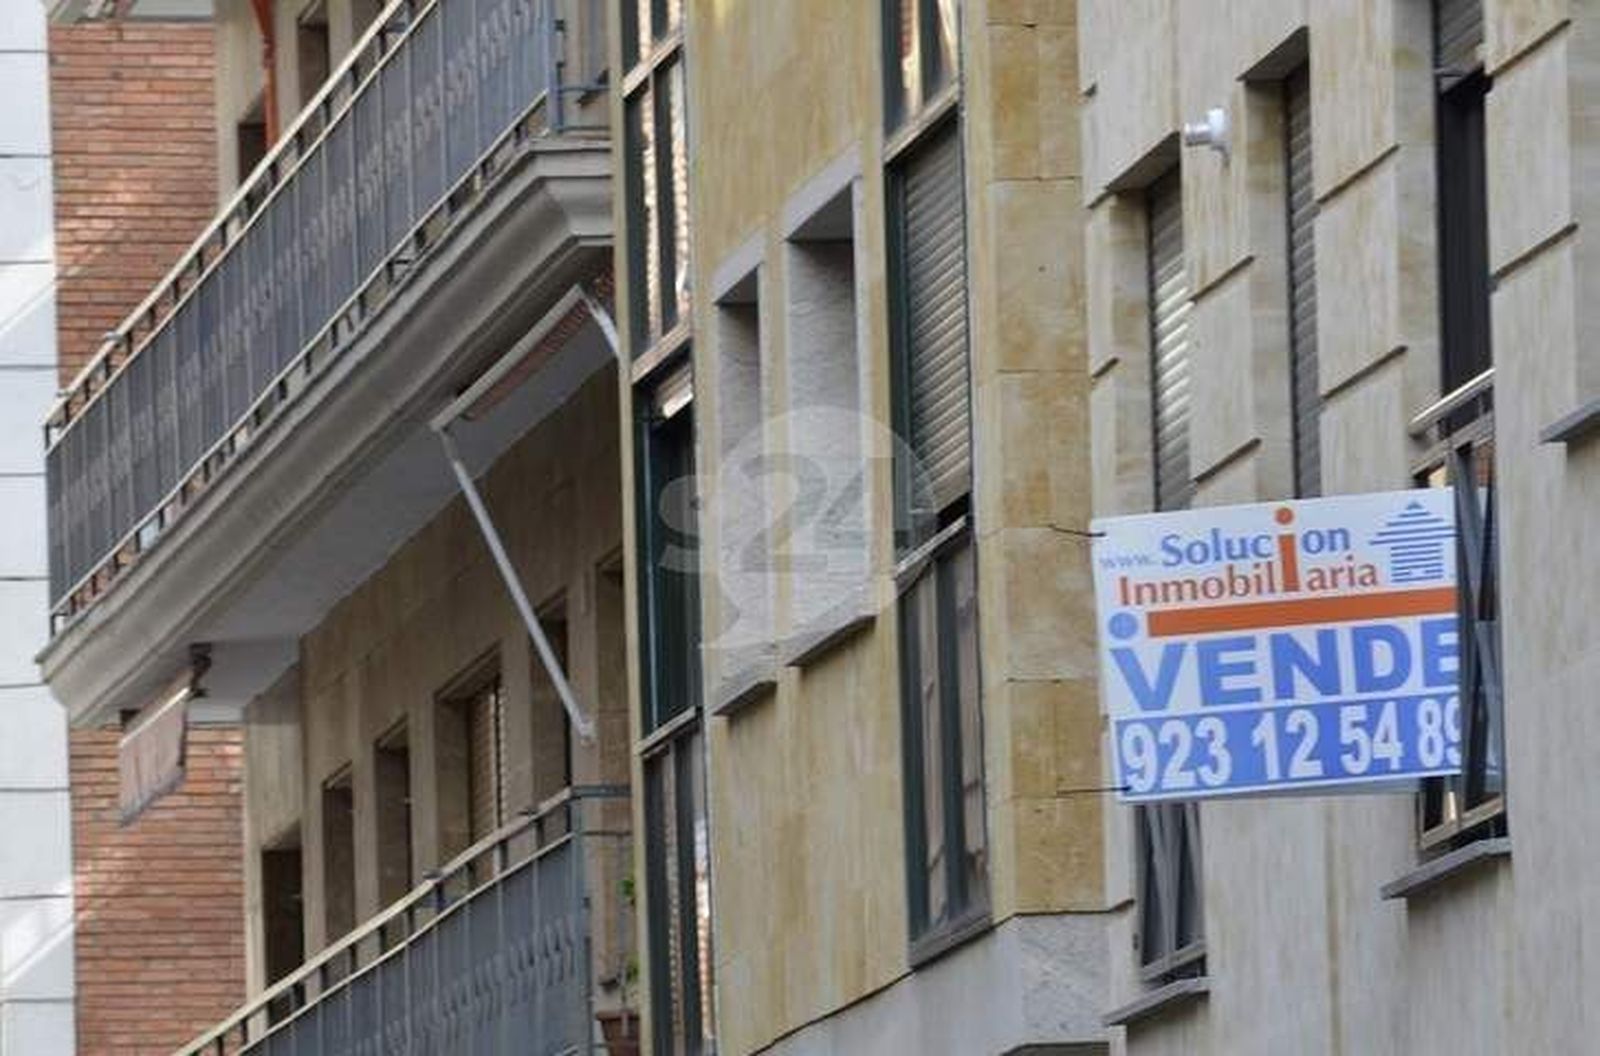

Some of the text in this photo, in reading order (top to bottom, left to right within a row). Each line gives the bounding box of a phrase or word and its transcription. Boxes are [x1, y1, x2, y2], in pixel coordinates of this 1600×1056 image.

[1161, 507, 1350, 568] Solucion
[1109, 618, 1460, 711] VENDE
[1121, 717, 1232, 793] 923
[1252, 708, 1324, 781] 12
[1340, 702, 1402, 775] 54
